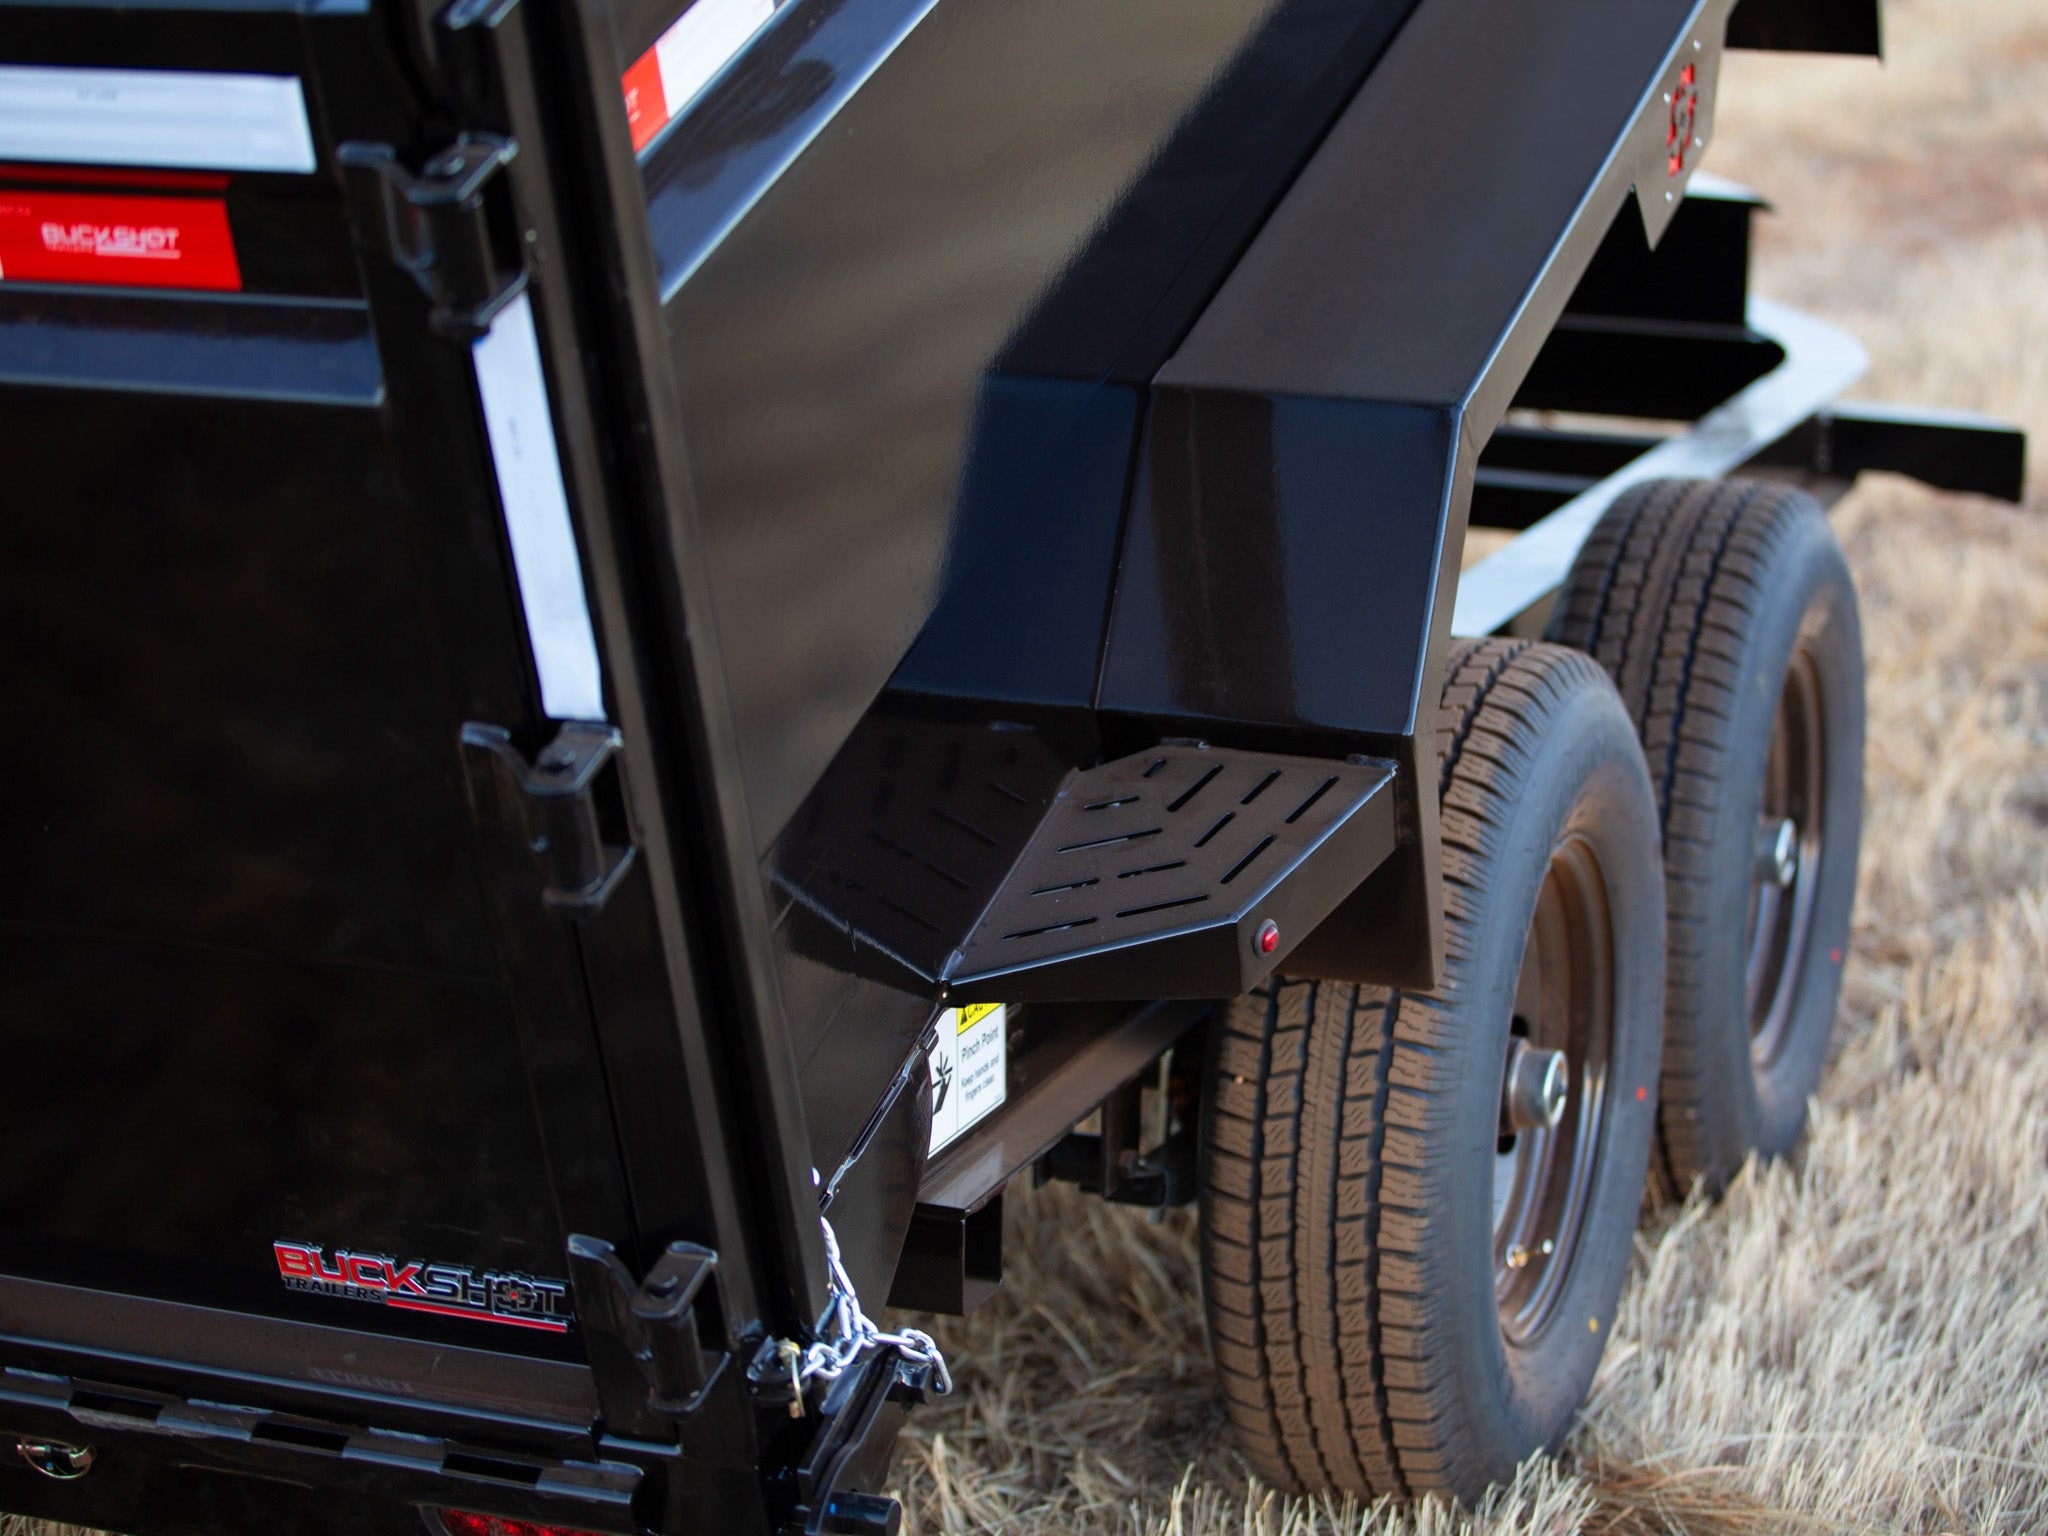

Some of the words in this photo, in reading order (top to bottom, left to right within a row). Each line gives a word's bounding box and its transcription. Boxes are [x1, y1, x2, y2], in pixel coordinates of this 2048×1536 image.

[41, 222, 180, 250] BUCKSHOT
[961, 1039, 980, 1063] Pinch
[982, 1025, 998, 1048] Point
[274, 1240, 567, 1315] BUCKSHOT
[283, 1276, 383, 1301] TRAILERS
